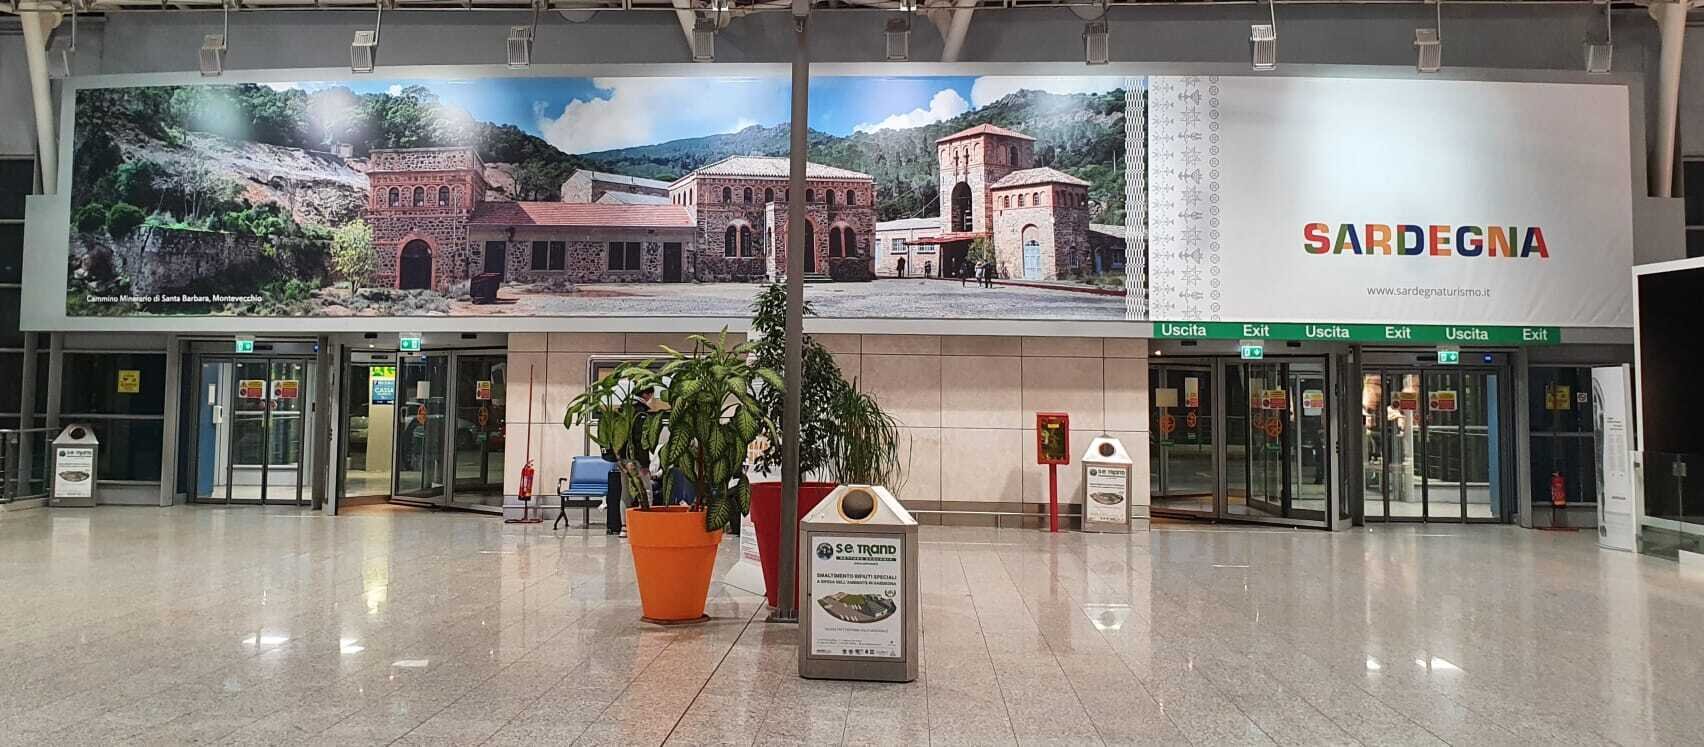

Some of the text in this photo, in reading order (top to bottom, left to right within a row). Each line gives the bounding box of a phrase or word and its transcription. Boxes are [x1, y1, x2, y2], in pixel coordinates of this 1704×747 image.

[1303, 222, 1549, 258] SARDEGNA
[86, 294, 263, 304] Cammino Minerario di Santa Barbara, Montevecchio
[1367, 285, 1490, 298] www.sardegnaturismo.it
[1161, 323, 1548, 341] Uscita Exit Uscita Exit Uscita Exit
